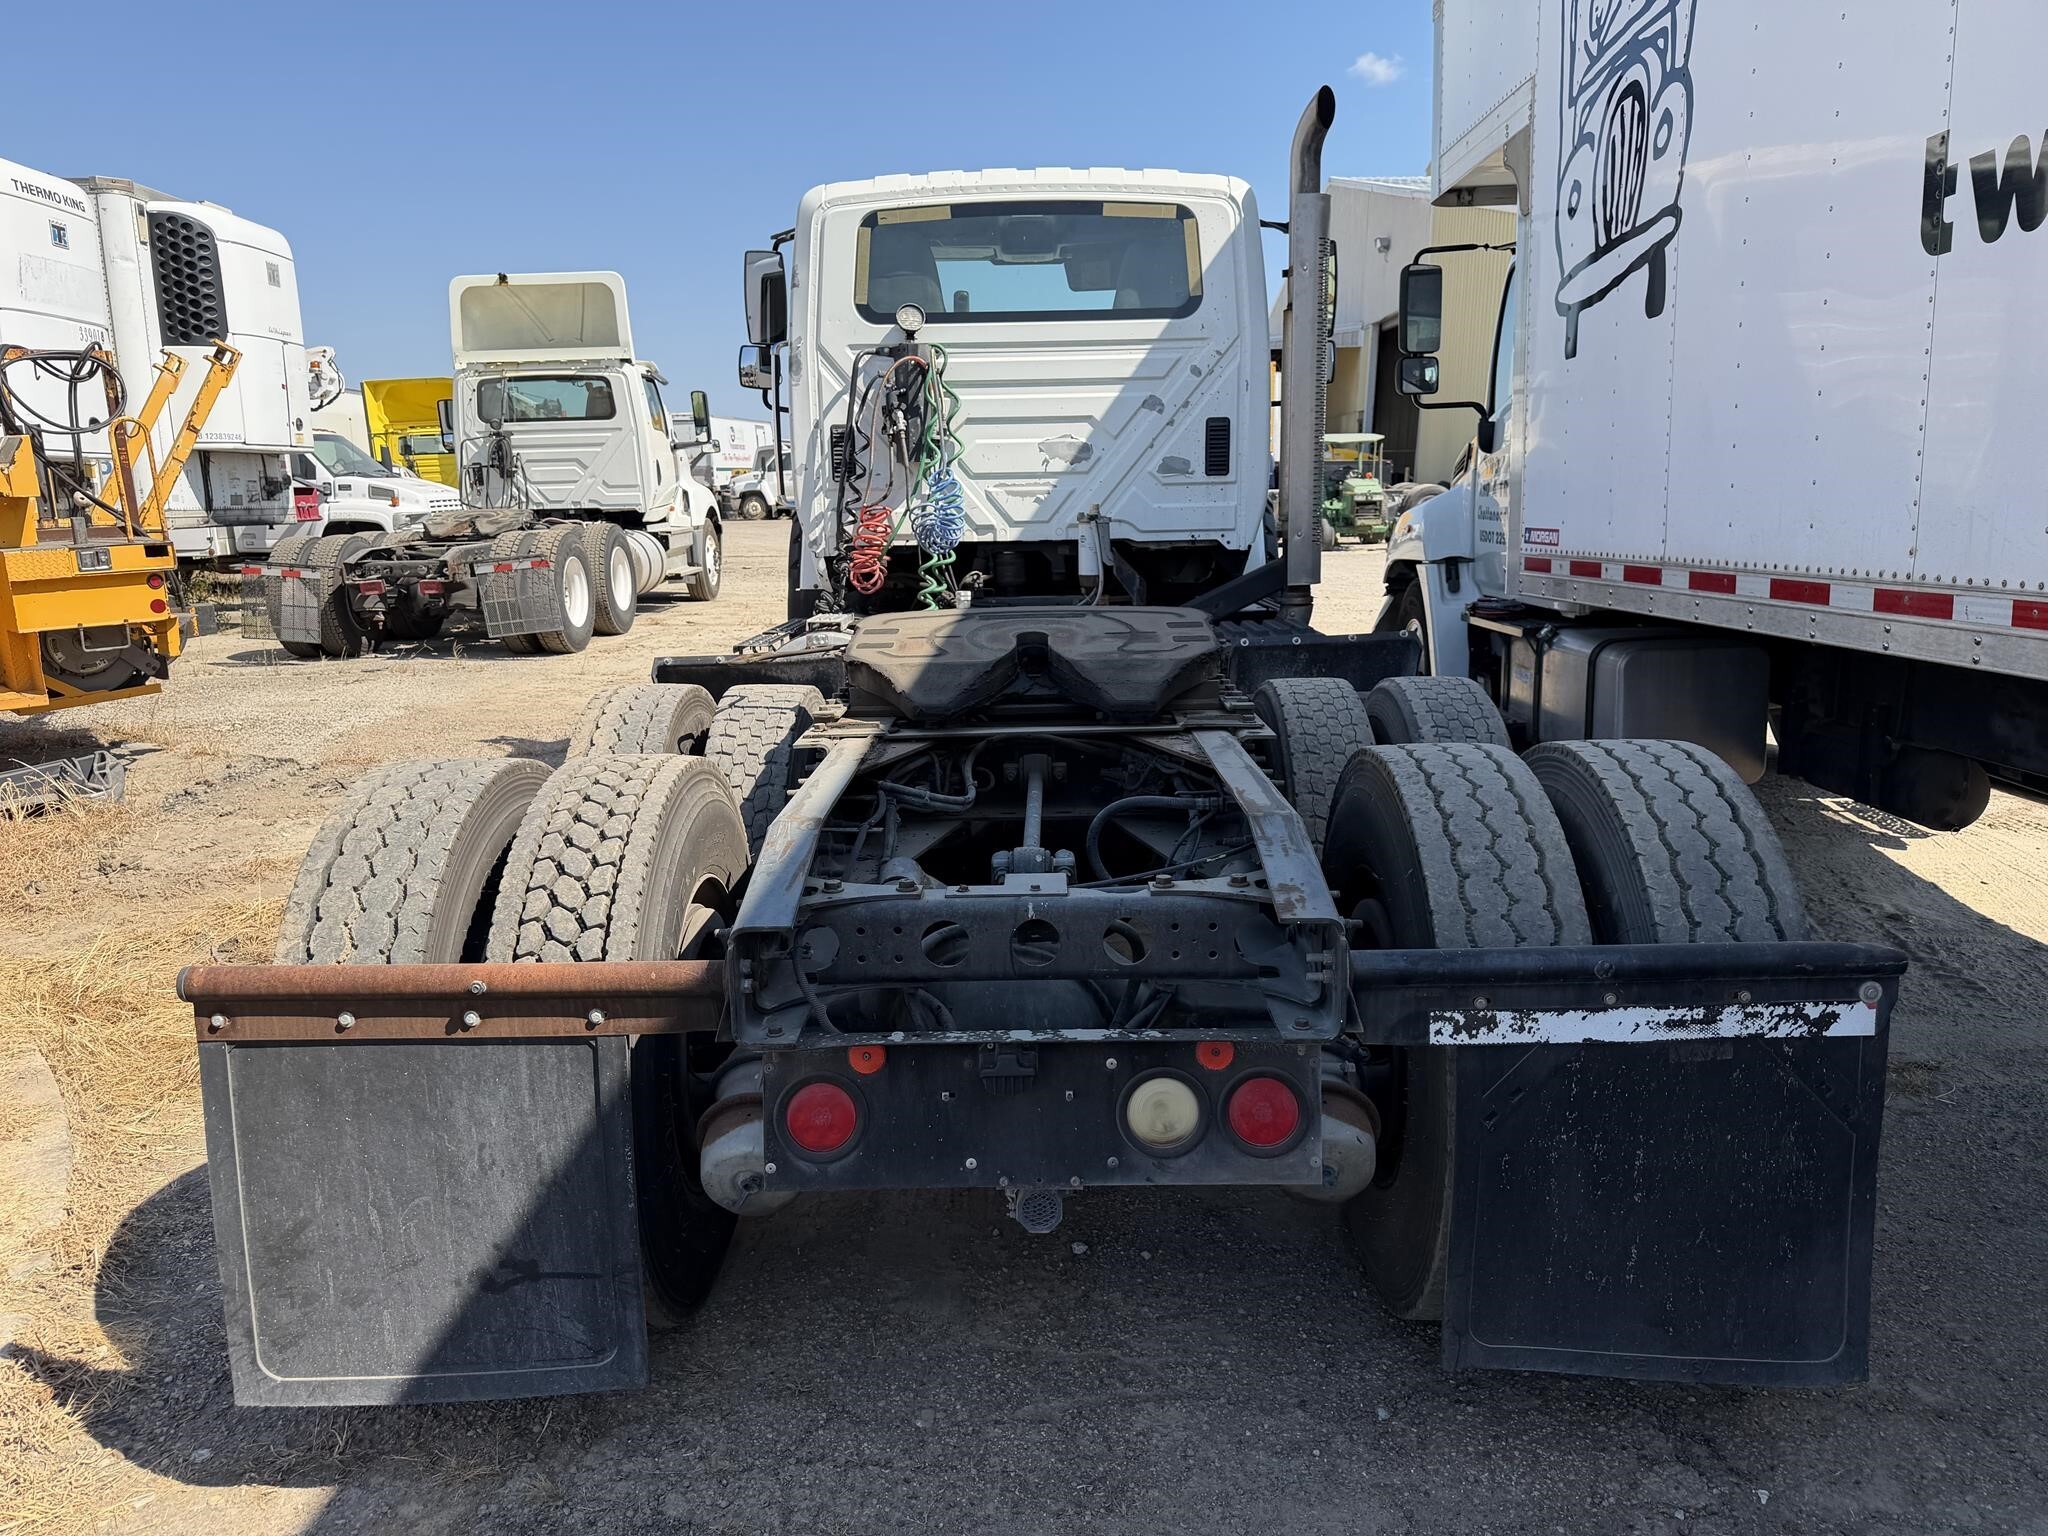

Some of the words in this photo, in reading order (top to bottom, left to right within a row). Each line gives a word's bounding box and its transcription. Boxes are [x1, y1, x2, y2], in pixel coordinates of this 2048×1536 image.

[10, 177, 62, 205] THERMO
[62, 194, 86, 213] KING
[1529, 530, 1559, 545] MORGAN
